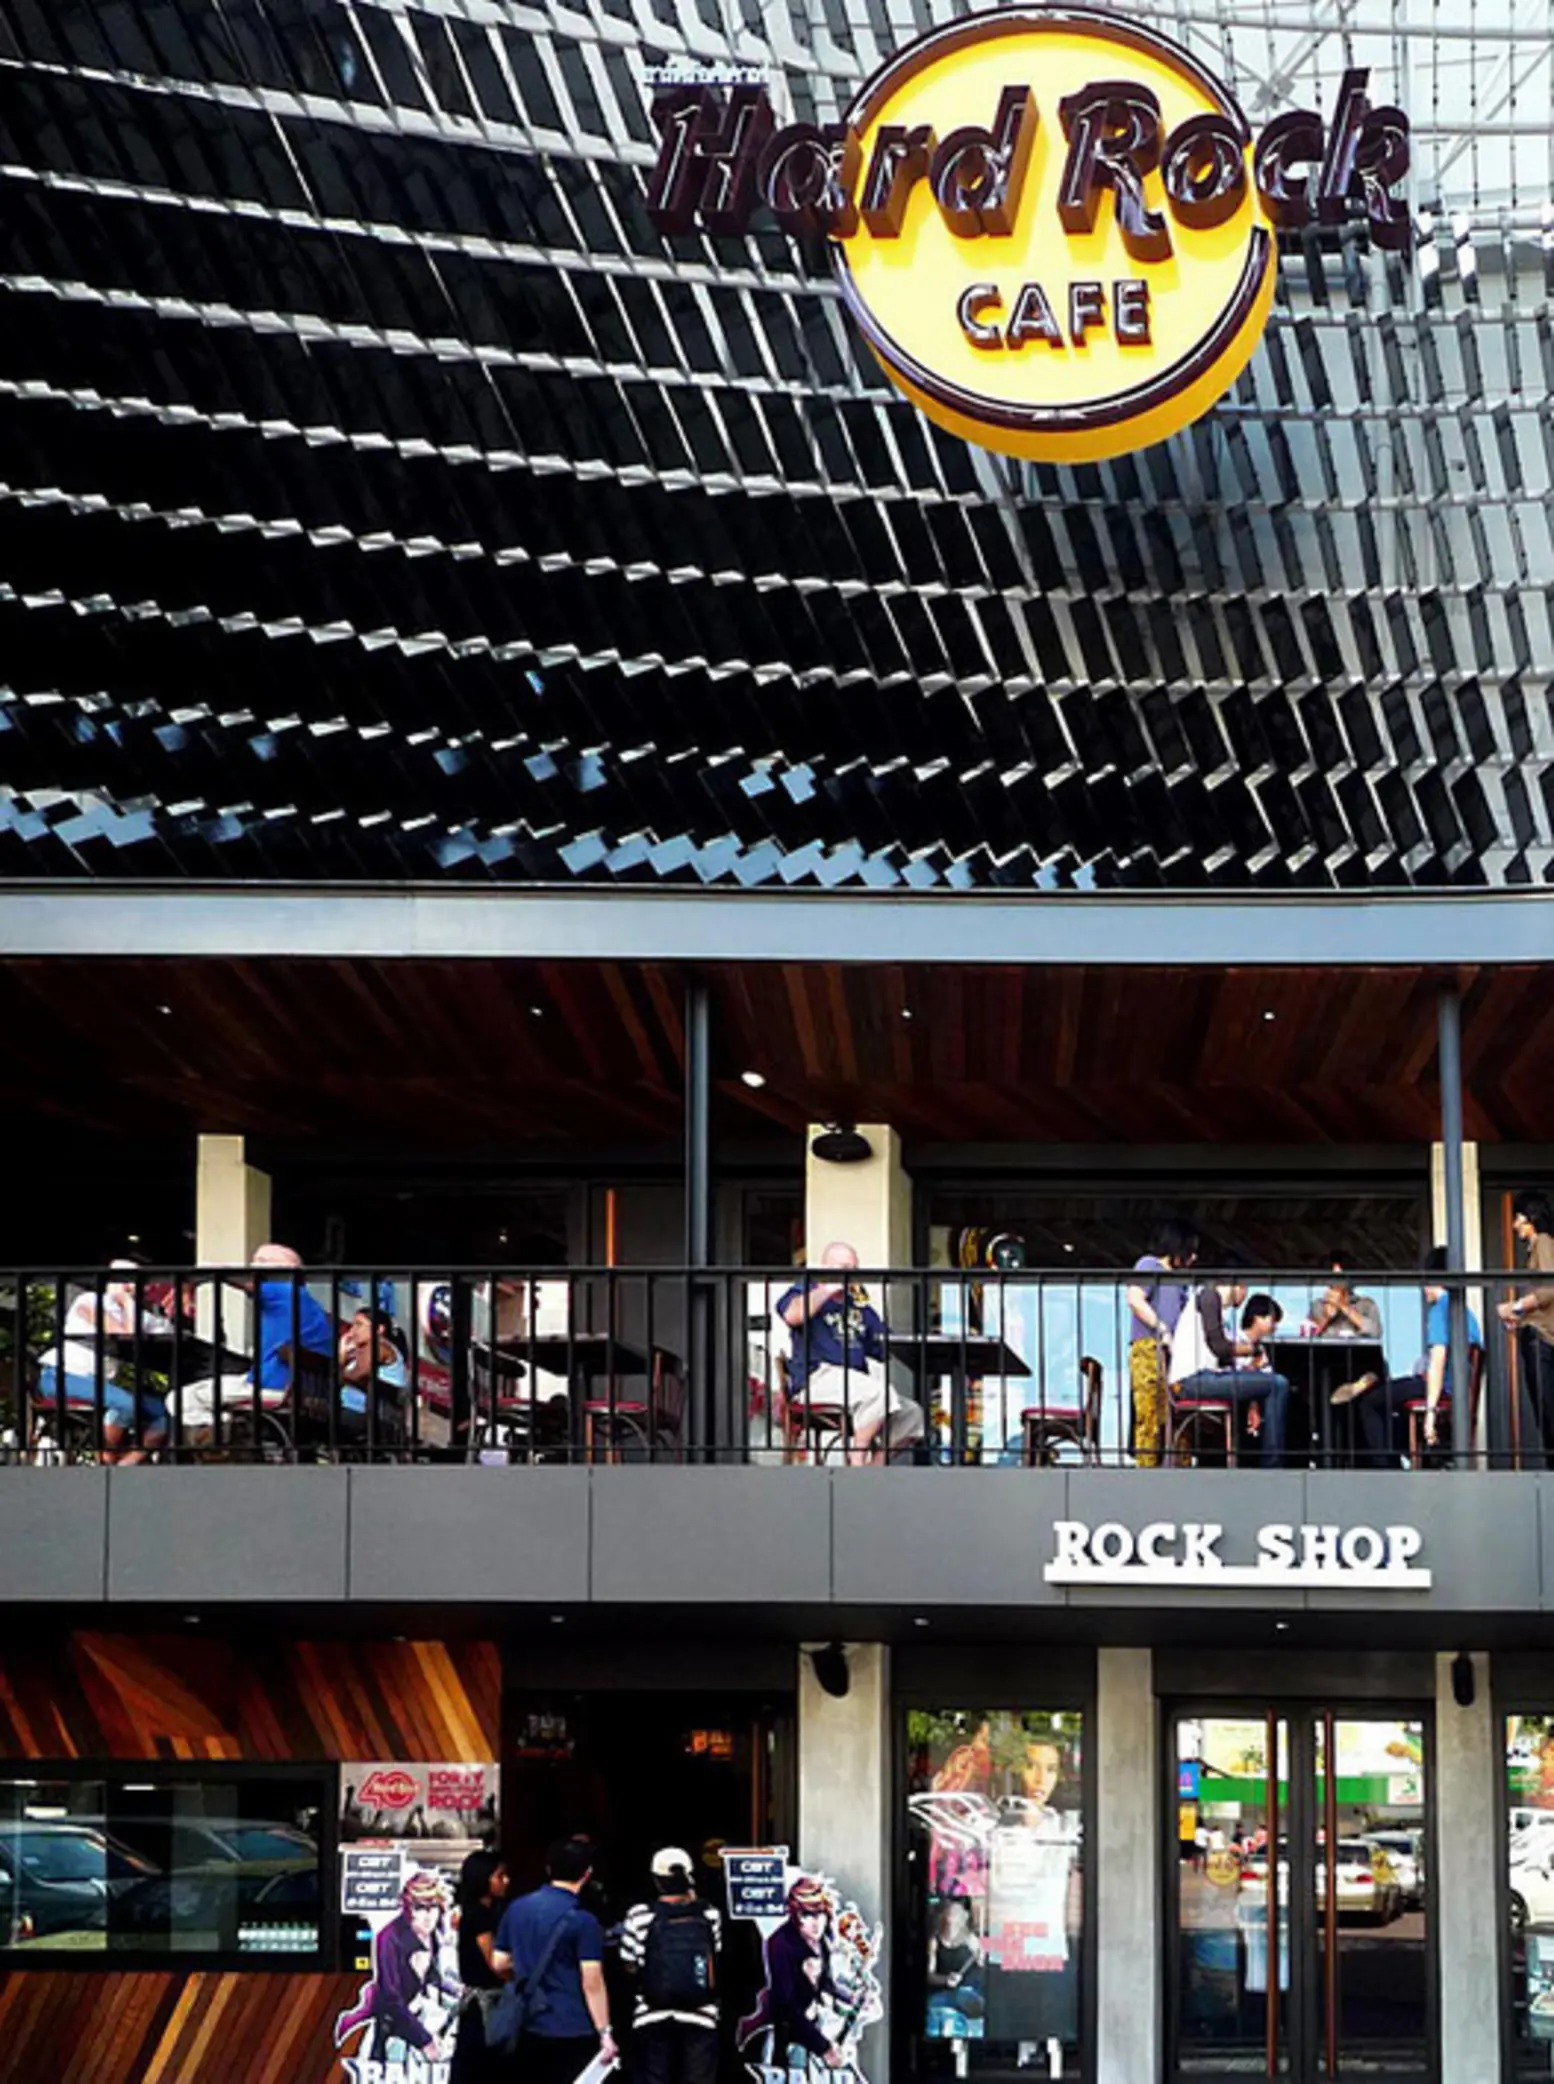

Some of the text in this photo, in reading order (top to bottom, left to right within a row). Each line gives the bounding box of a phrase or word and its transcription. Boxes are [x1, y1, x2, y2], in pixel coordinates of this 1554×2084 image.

[648, 67, 1411, 262] Hard Rock
[956, 279, 1152, 350] CAFE
[1052, 1520, 1422, 1570] ROCK SHOP
